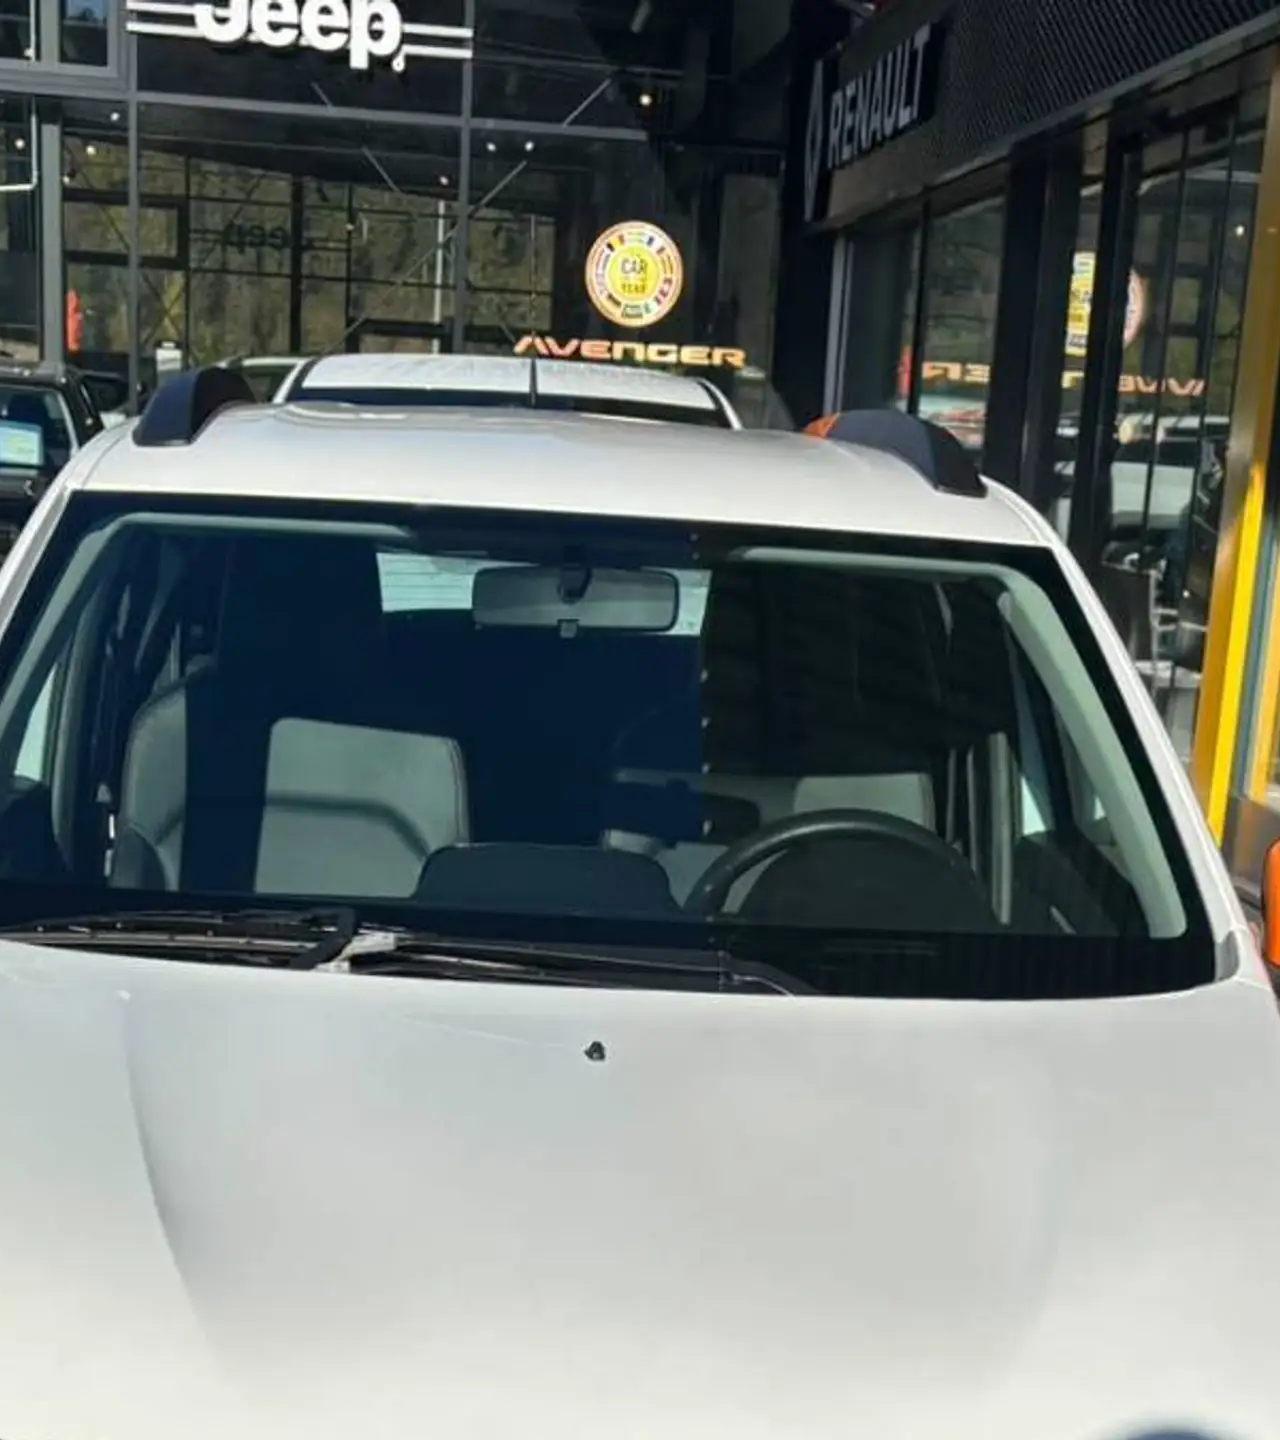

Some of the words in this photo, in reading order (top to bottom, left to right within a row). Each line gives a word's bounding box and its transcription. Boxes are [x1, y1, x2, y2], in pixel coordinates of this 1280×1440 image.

[194, 0, 403, 70] Jeep
[827, 21, 930, 169] RENAULT
[513, 334, 746, 367] AVENGER
